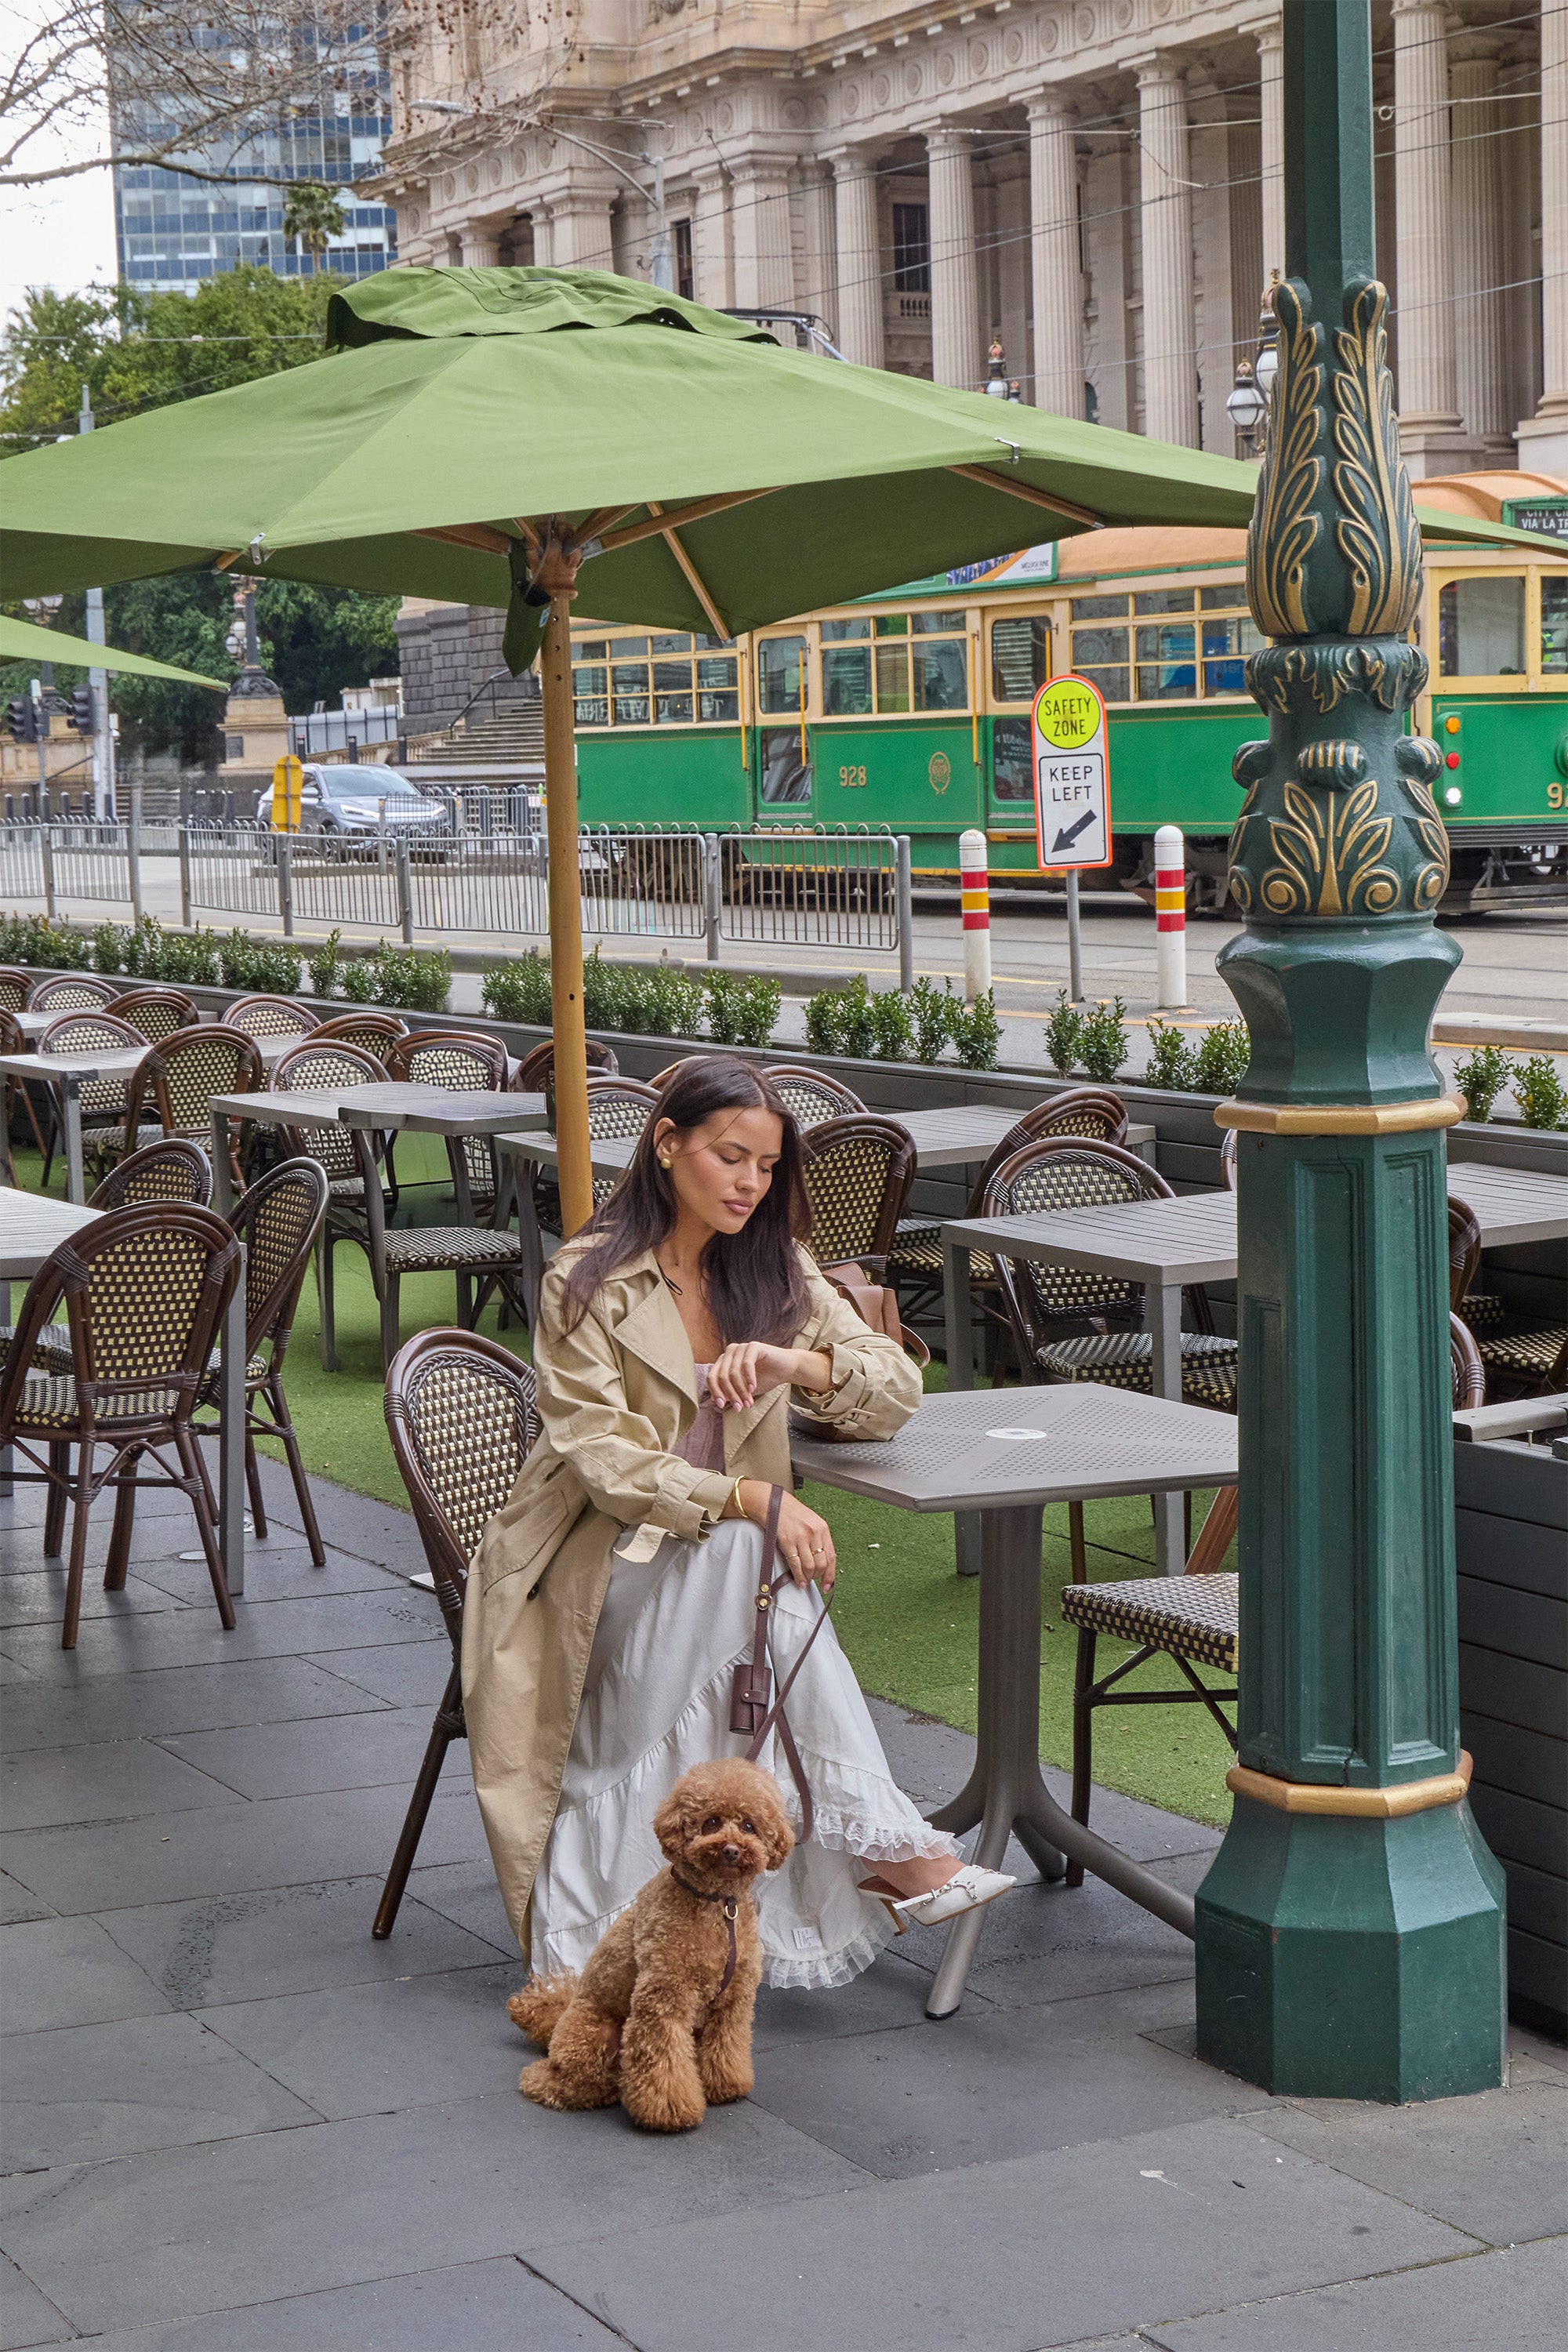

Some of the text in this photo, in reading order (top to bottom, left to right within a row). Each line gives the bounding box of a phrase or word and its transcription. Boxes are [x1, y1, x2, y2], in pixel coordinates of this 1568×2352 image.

[1521, 518, 1538, 529] VIA
[1542, 518, 1555, 529] LA
[1044, 697, 1091, 716] SAFETY
[1053, 719, 1087, 737] ZONE
[839, 765, 867, 788] 928
[1050, 765, 1093, 782] KEEP
[1052, 786, 1092, 802] LEFT
[1547, 782, 1568, 810] 9
